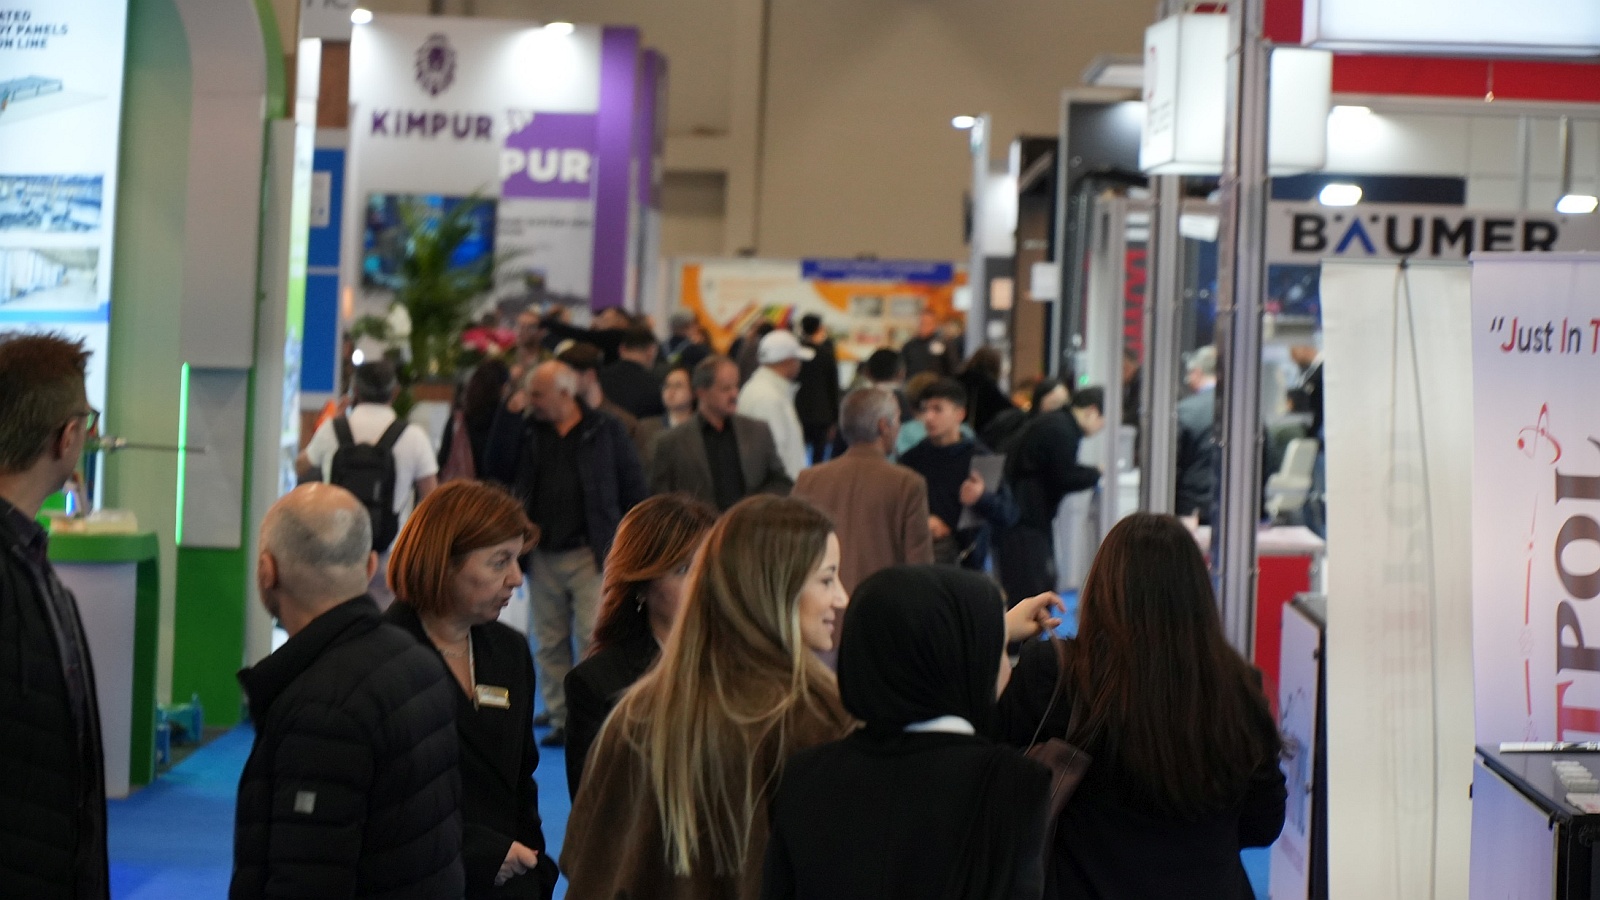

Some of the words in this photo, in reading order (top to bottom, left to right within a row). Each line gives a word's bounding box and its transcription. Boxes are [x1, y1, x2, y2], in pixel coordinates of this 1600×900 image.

[16, 24, 69, 35] PANELS
[371, 108, 493, 140] KIMPUR
[1560, 316, 1583, 354] In
